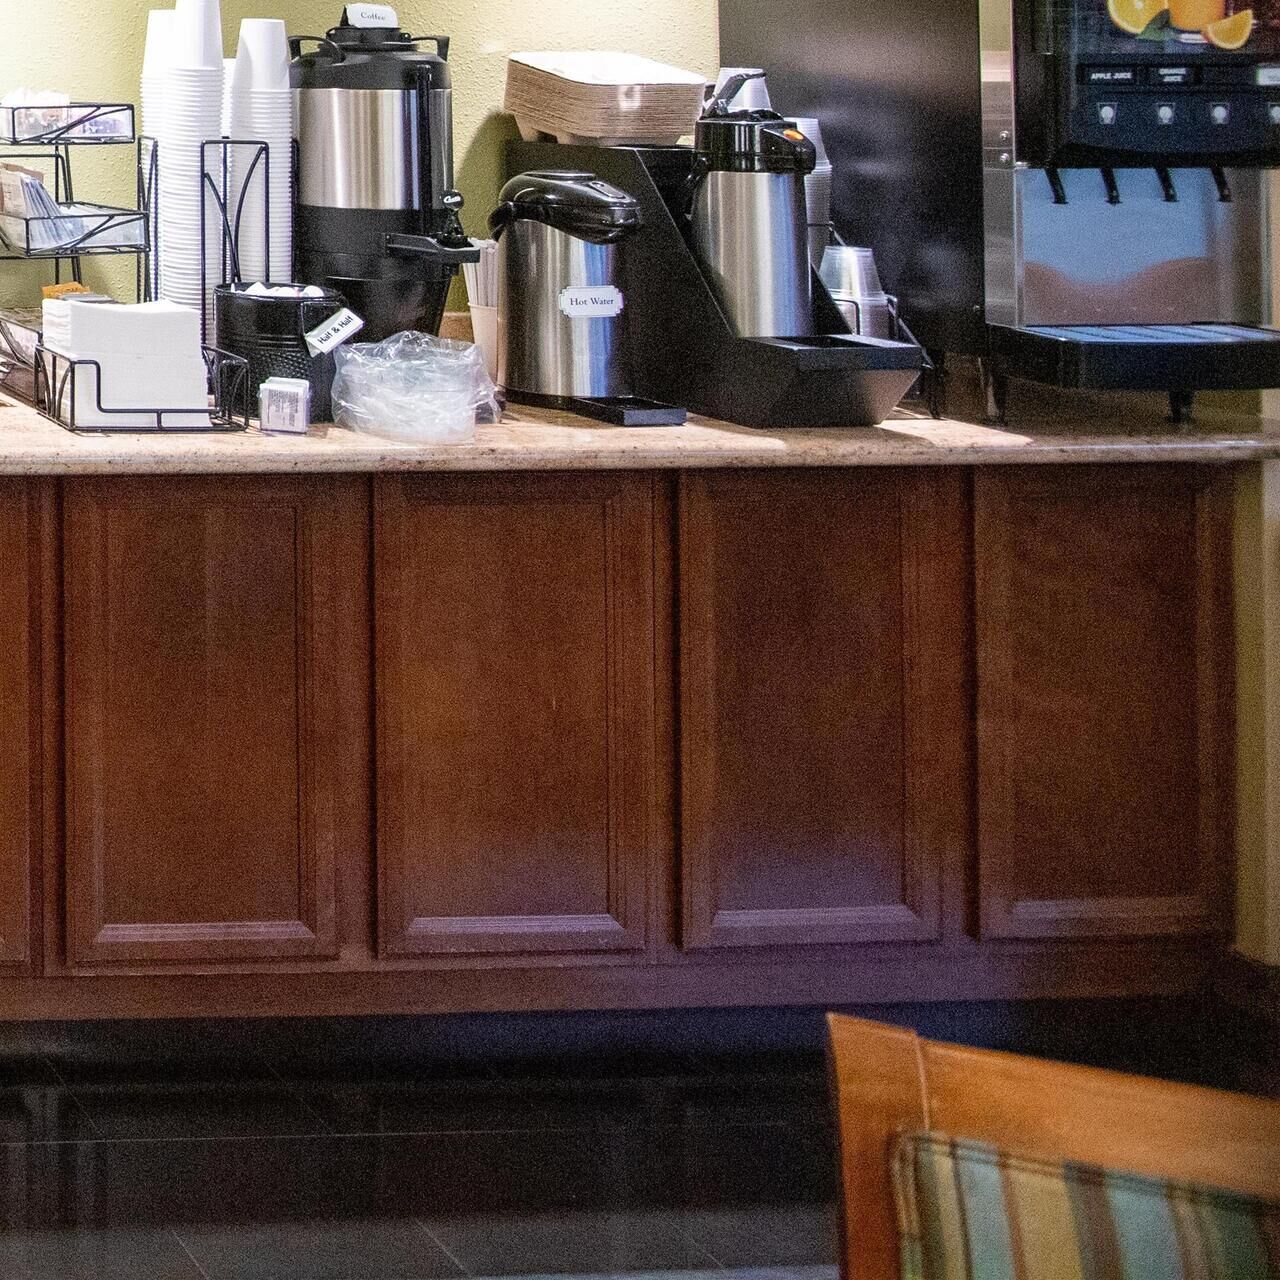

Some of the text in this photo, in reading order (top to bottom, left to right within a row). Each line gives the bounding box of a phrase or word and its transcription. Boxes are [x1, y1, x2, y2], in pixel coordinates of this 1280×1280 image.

[360, 11, 385, 21] Coffee
[1091, 71, 1132, 80] APPLE JUICE
[1159, 67, 1186, 75] ORANGE
[570, 296, 614, 306] Hot Water
[317, 331, 334, 344] Half
[338, 315, 354, 328] Half
